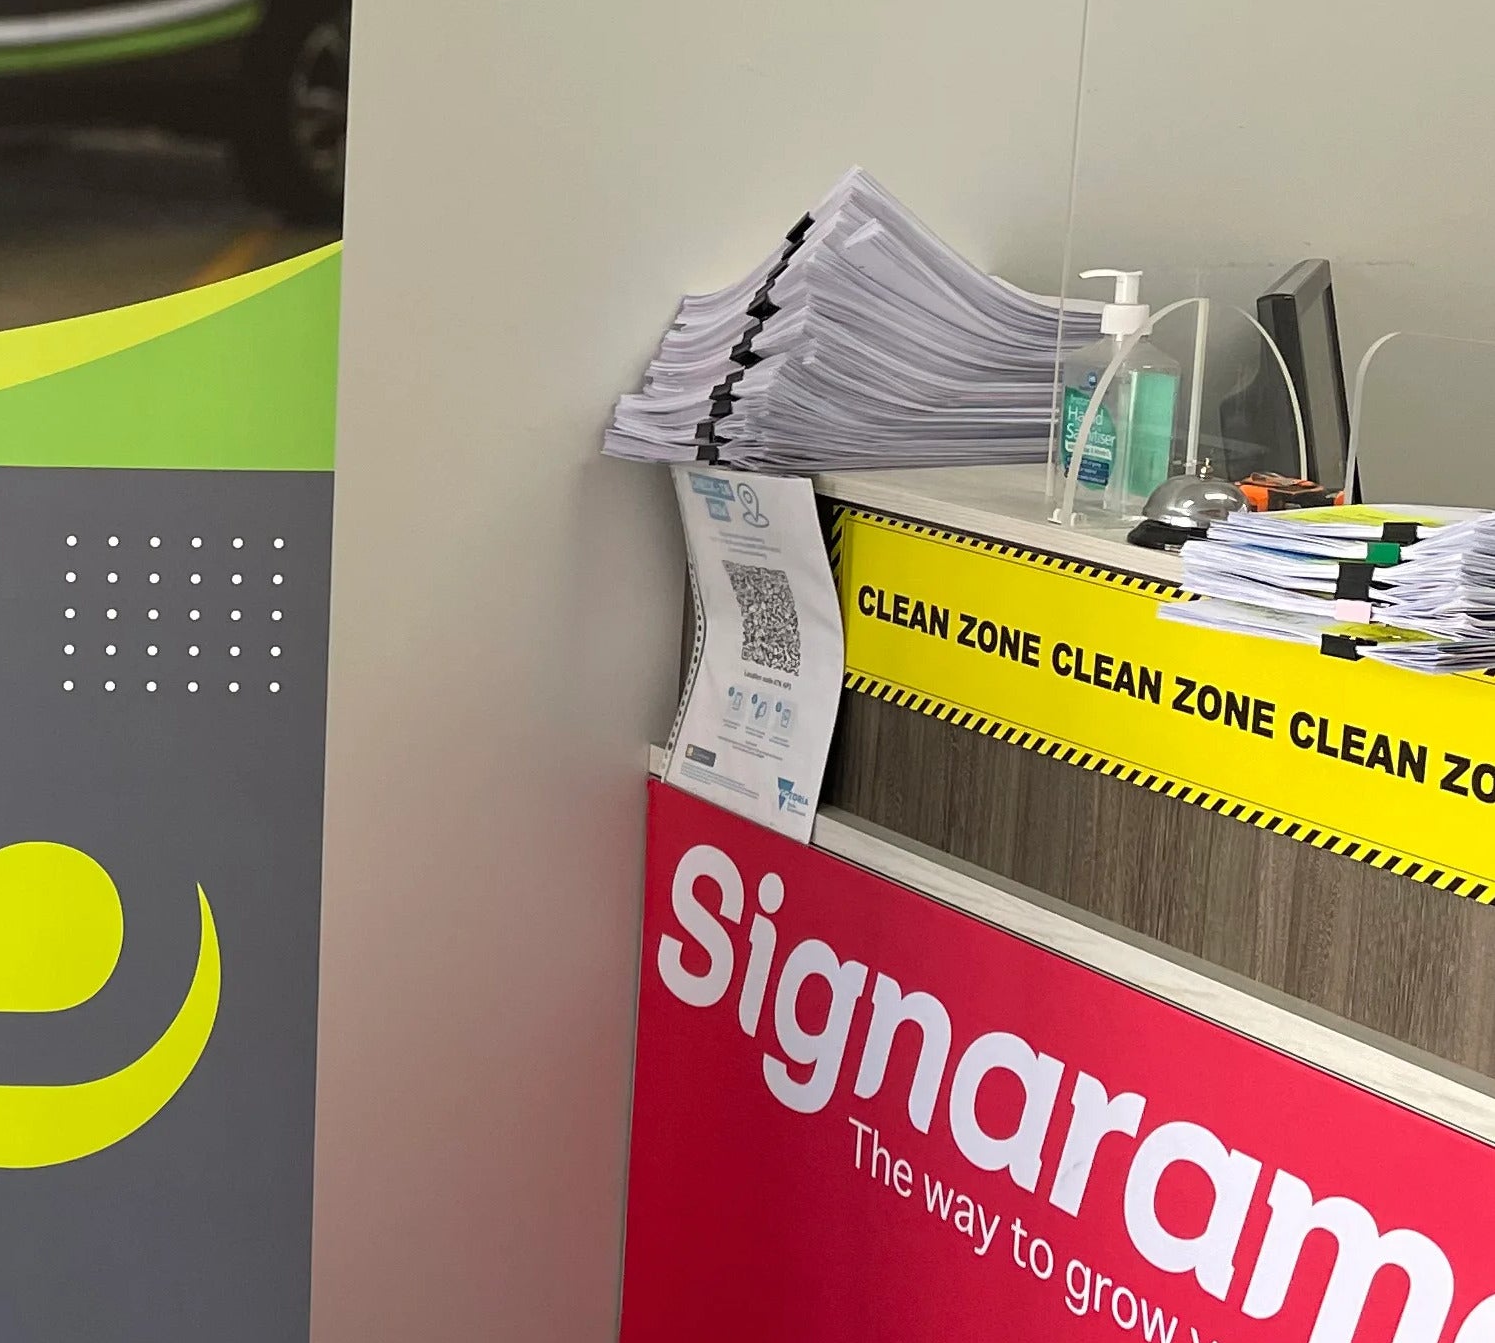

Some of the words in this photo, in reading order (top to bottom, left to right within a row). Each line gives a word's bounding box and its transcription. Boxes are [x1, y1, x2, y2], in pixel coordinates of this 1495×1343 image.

[1065, 422, 1116, 447] Saitiser
[1068, 405, 1104, 425] Had
[858, 585, 950, 640] CLEAN
[956, 613, 1040, 668] ZONE
[1051, 641, 1162, 704] CLEAN
[1171, 676, 1276, 738] ZONE
[1289, 711, 1428, 784] CLEAN
[1440, 752, 1495, 804] ZO
[849, 1116, 914, 1199] The
[923, 1172, 1001, 1256] way
[1011, 1217, 1055, 1280] to
